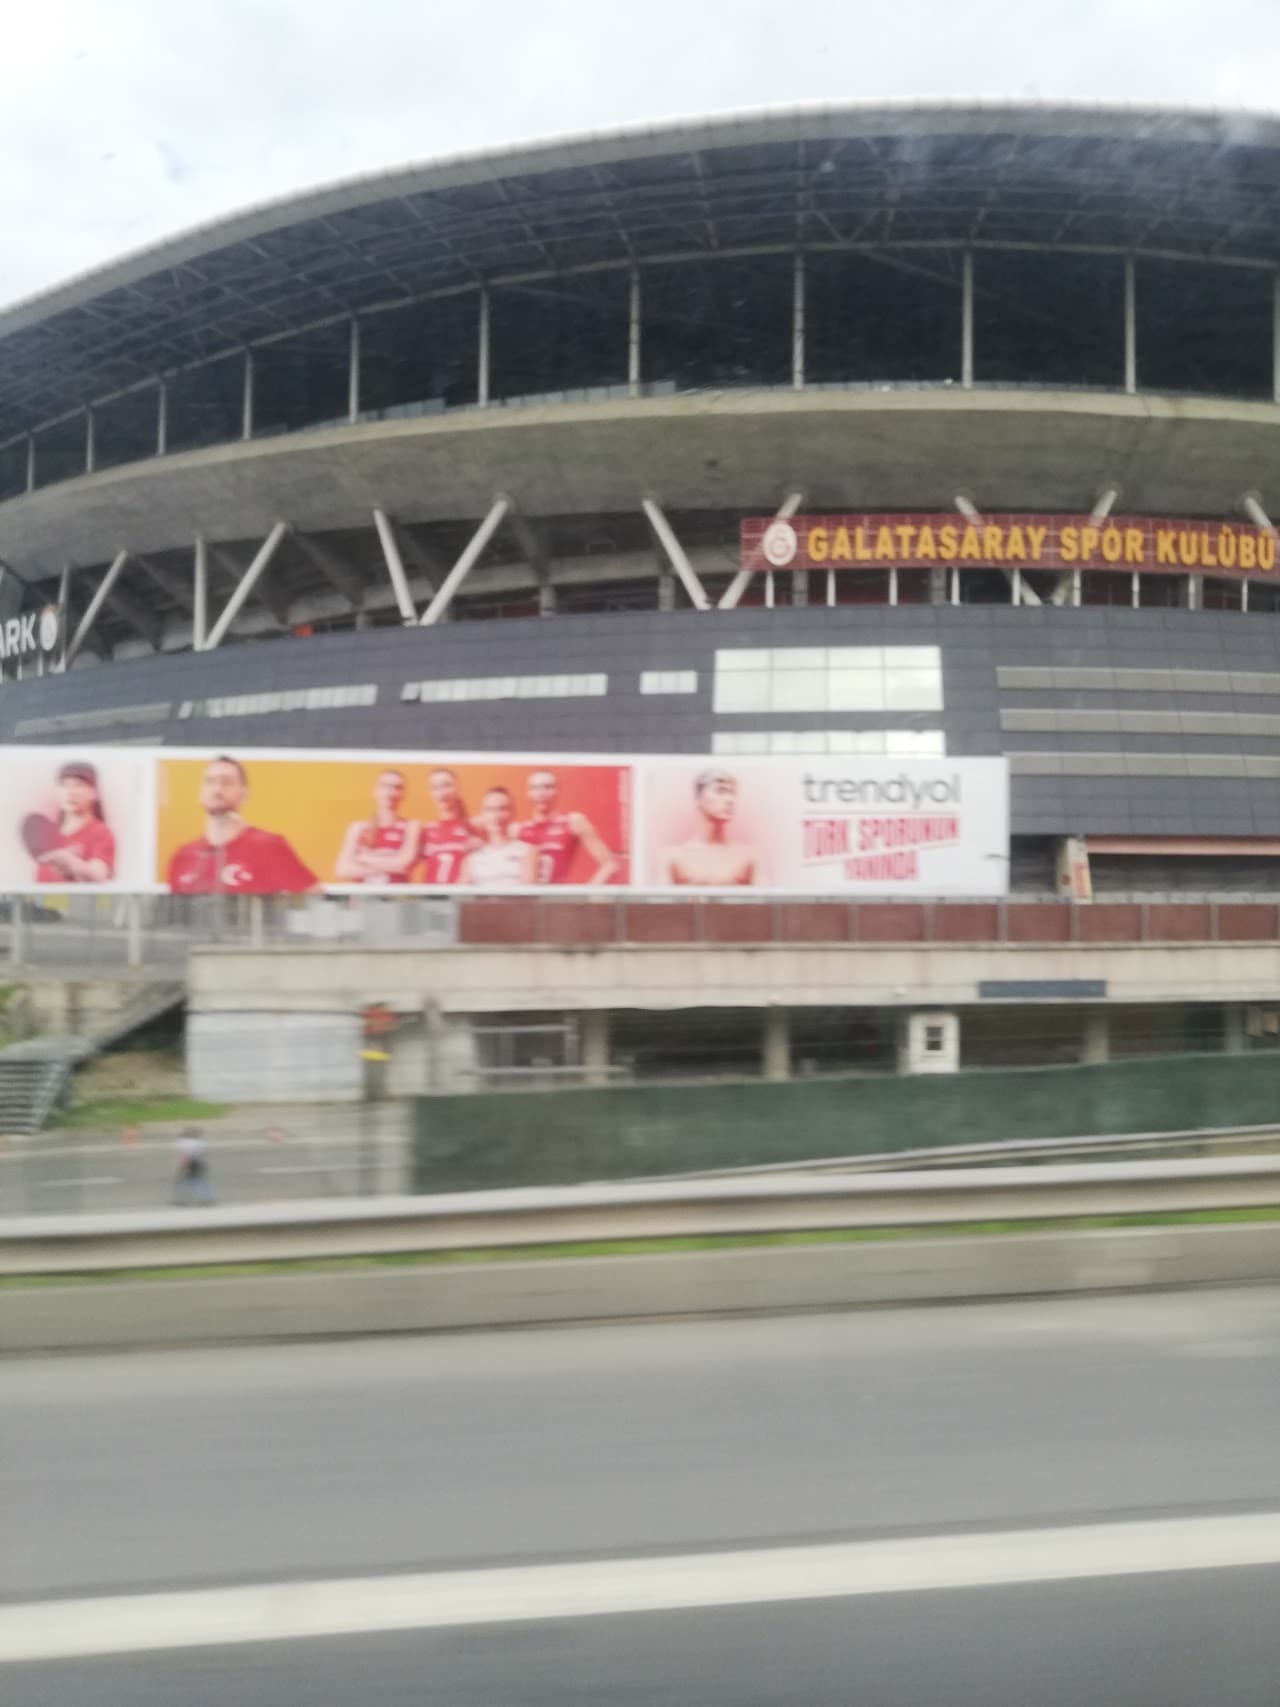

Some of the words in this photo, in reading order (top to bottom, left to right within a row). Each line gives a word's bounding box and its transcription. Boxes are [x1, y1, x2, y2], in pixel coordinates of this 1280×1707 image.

[807, 525, 1046, 561] GALATASARAY
[1060, 526, 1144, 562] SPOR
[1156, 524, 1275, 570] KULÜBÜ
[803, 773, 960, 808] trendyol
